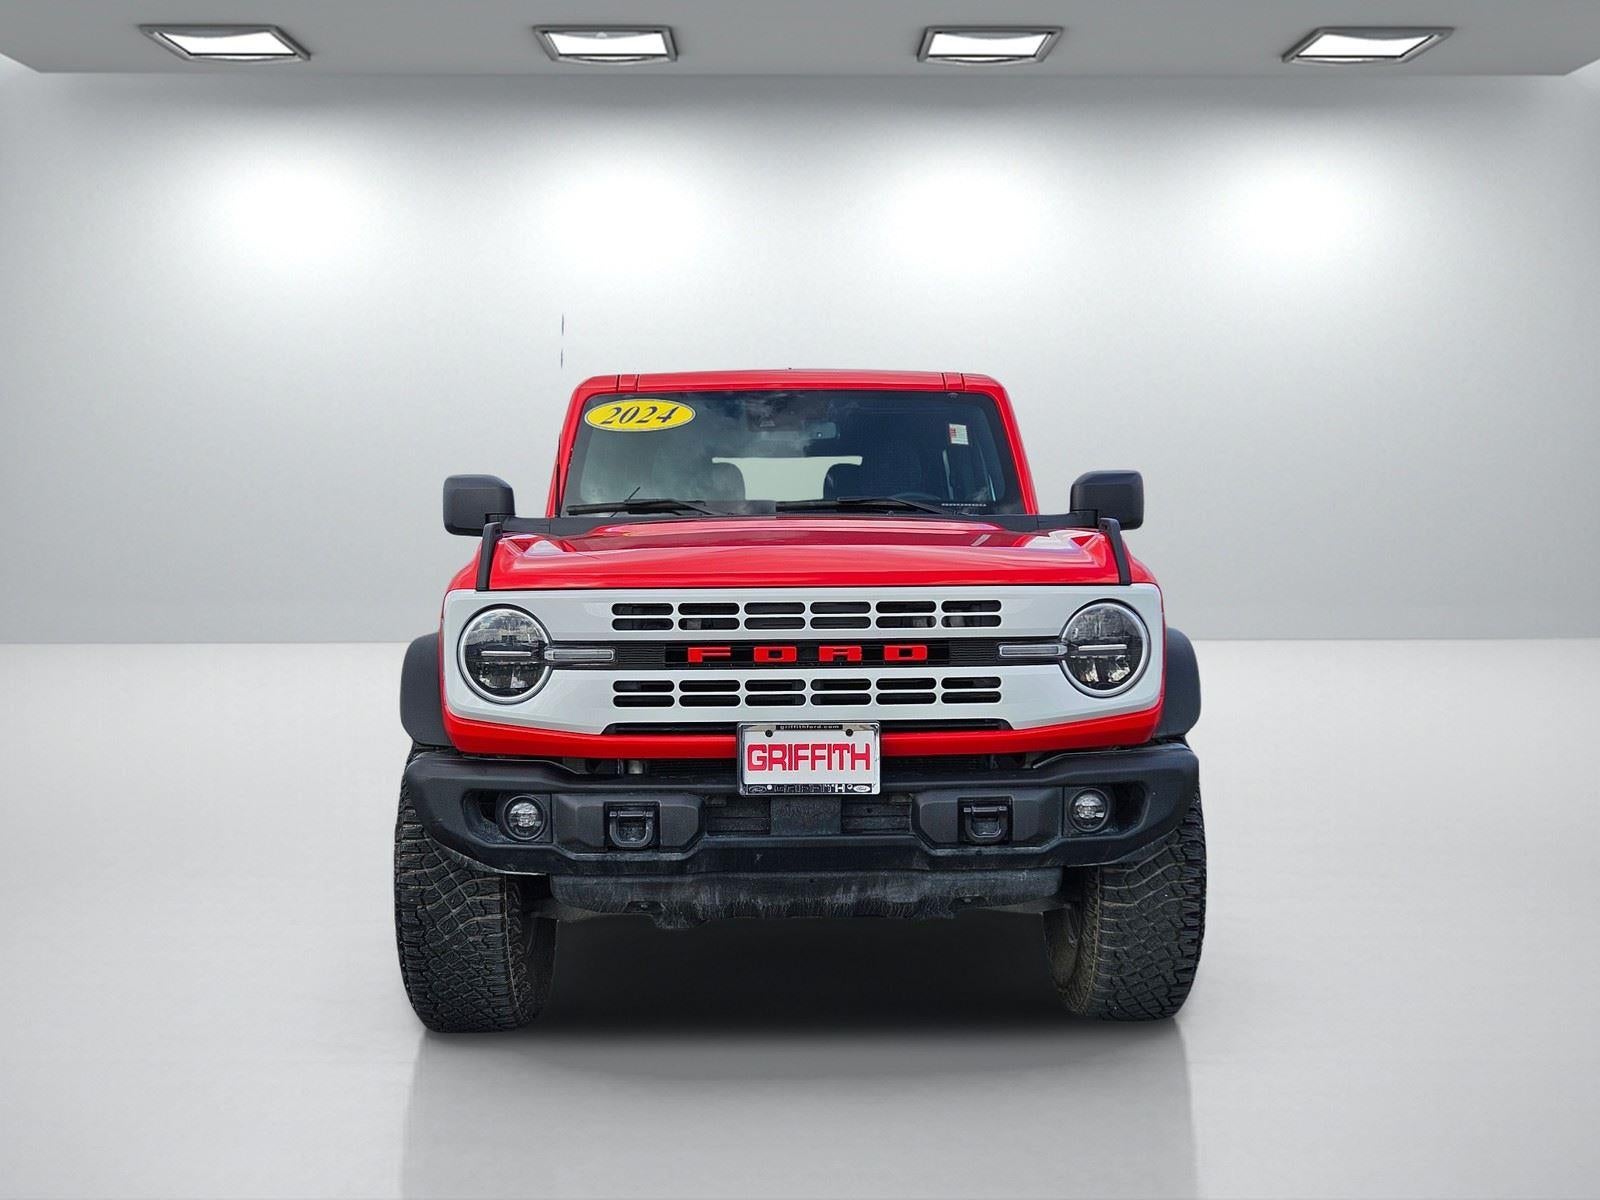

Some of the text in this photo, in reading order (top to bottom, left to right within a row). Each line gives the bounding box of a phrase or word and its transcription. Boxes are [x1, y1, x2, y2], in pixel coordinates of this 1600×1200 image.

[601, 406, 680, 425] 2024
[687, 645, 928, 663] FORD
[747, 743, 871, 771] GRIFFITH
